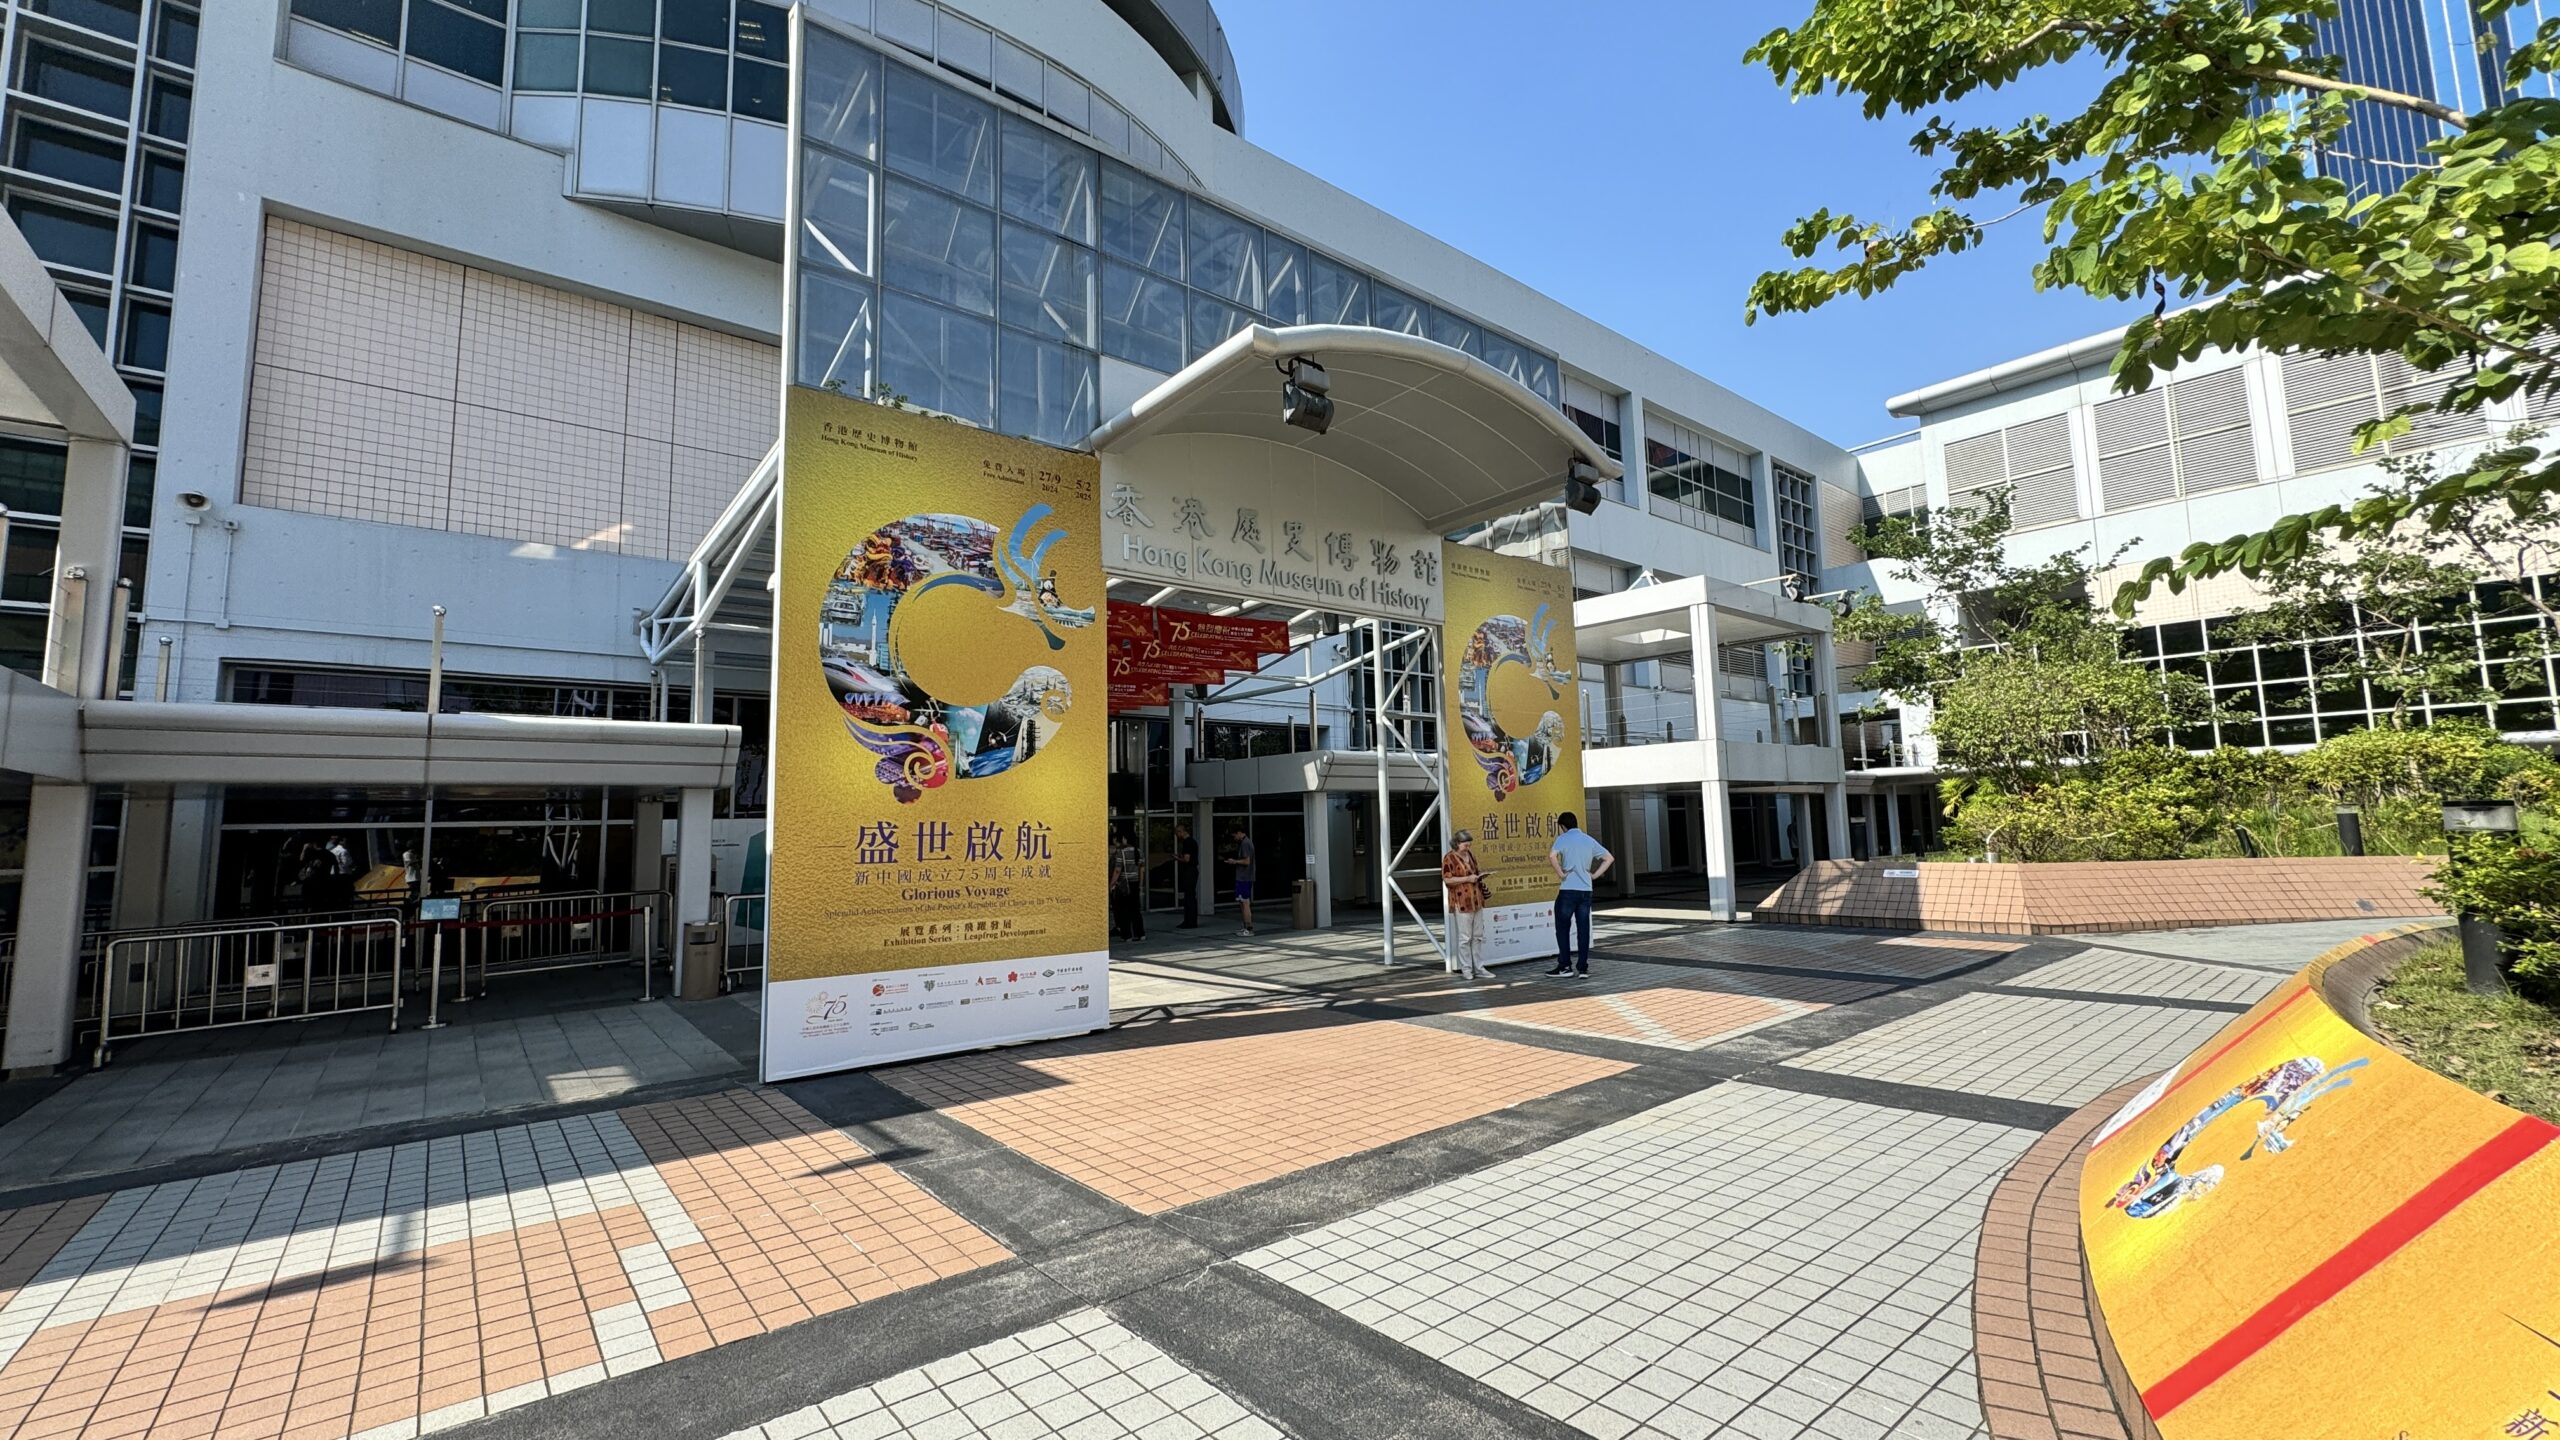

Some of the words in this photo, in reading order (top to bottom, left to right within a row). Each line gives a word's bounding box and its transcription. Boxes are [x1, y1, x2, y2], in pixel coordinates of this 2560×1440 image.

[821, 434, 840, 445] Hong
[841, 439, 858, 449] Kong
[1039, 470, 1061, 485] 27/9
[1075, 479, 1091, 492] 5/2
[1041, 483, 1058, 494] 2024
[1075, 491, 1092, 501] 2025
[1122, 532, 1188, 578] Hong
[1196, 548, 1253, 588] Kong
[1259, 557, 1343, 598] Museum
[1349, 576, 1368, 601] of
[1371, 579, 1429, 617] History
[1168, 621, 1191, 643] 75
[1141, 639, 1161, 660] 75
[1111, 656, 1132, 677] 75
[1482, 812, 1560, 840] 盛世啟航
[854, 820, 1052, 865] 盛世啟航
[855, 864, 1051, 886] 新中國成立75周年成就
[901, 886, 961, 901] Glorious
[964, 885, 1010, 899] Voyage
[824, 908, 859, 919] Splendid
[915, 904, 924, 913] of
[924, 903, 936, 912] the
[999, 899, 1006, 908] of
[883, 936, 927, 947] Exhibition
[928, 935, 952, 944] Series
[964, 930, 999, 941] Leapfrog
[1000, 927, 1047, 938] Development
[823, 993, 849, 1021] 75
